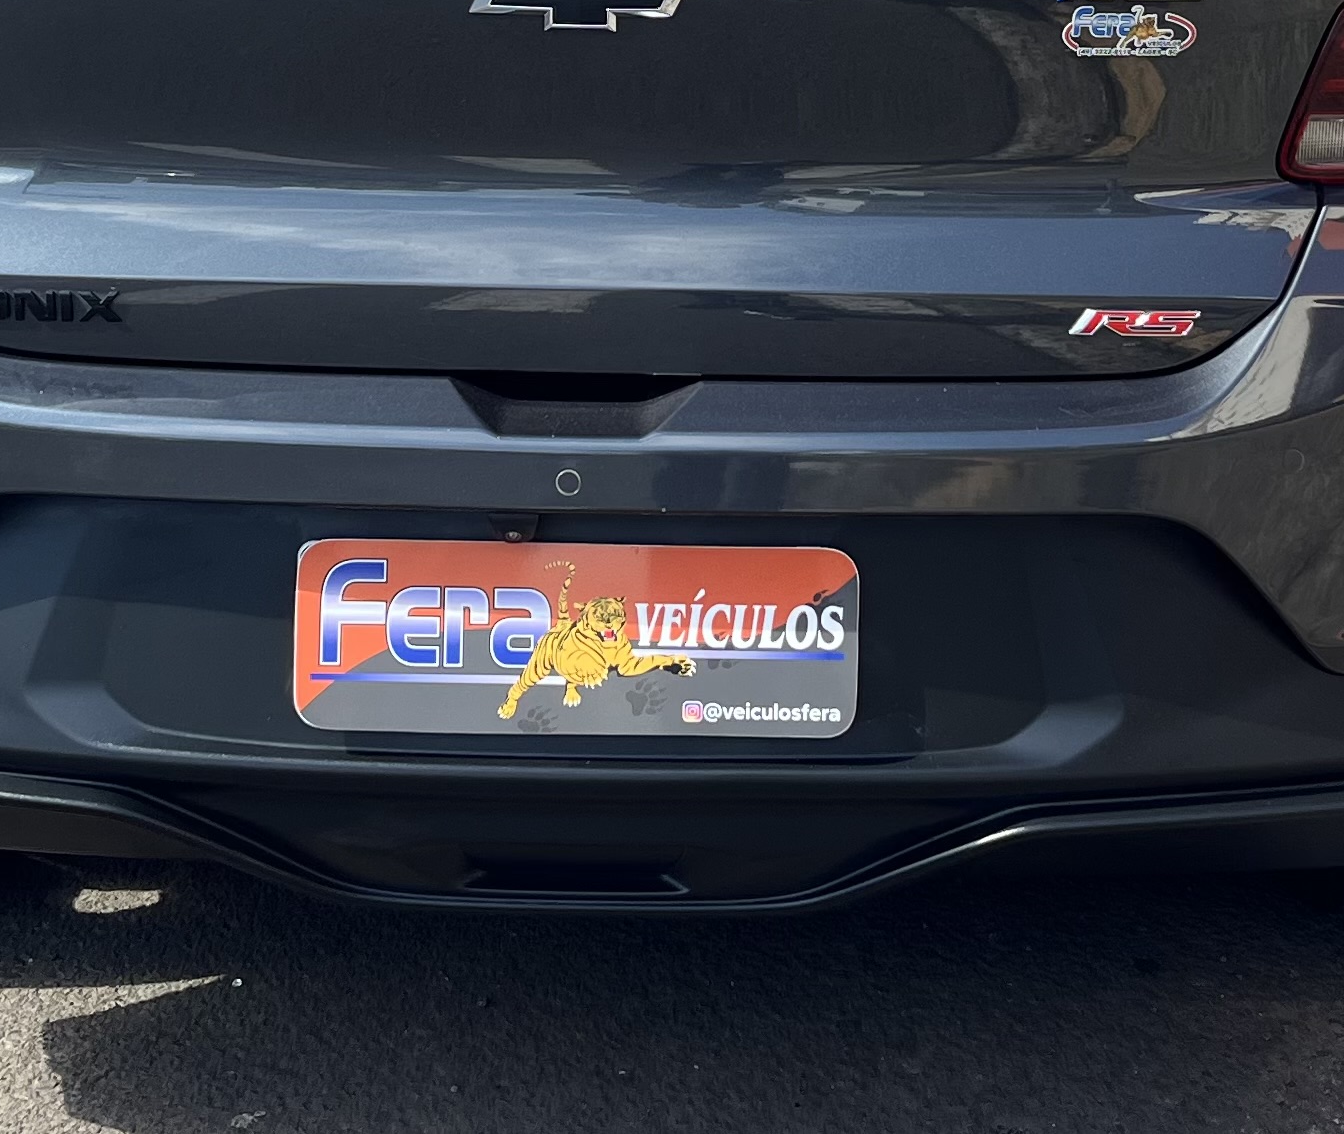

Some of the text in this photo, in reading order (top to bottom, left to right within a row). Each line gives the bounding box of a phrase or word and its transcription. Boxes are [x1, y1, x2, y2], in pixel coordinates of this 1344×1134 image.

[1068, 308, 1201, 336] RS
[320, 558, 845, 668] Fera VEÍCULOS
[703, 702, 841, 722] @veiculosfera
